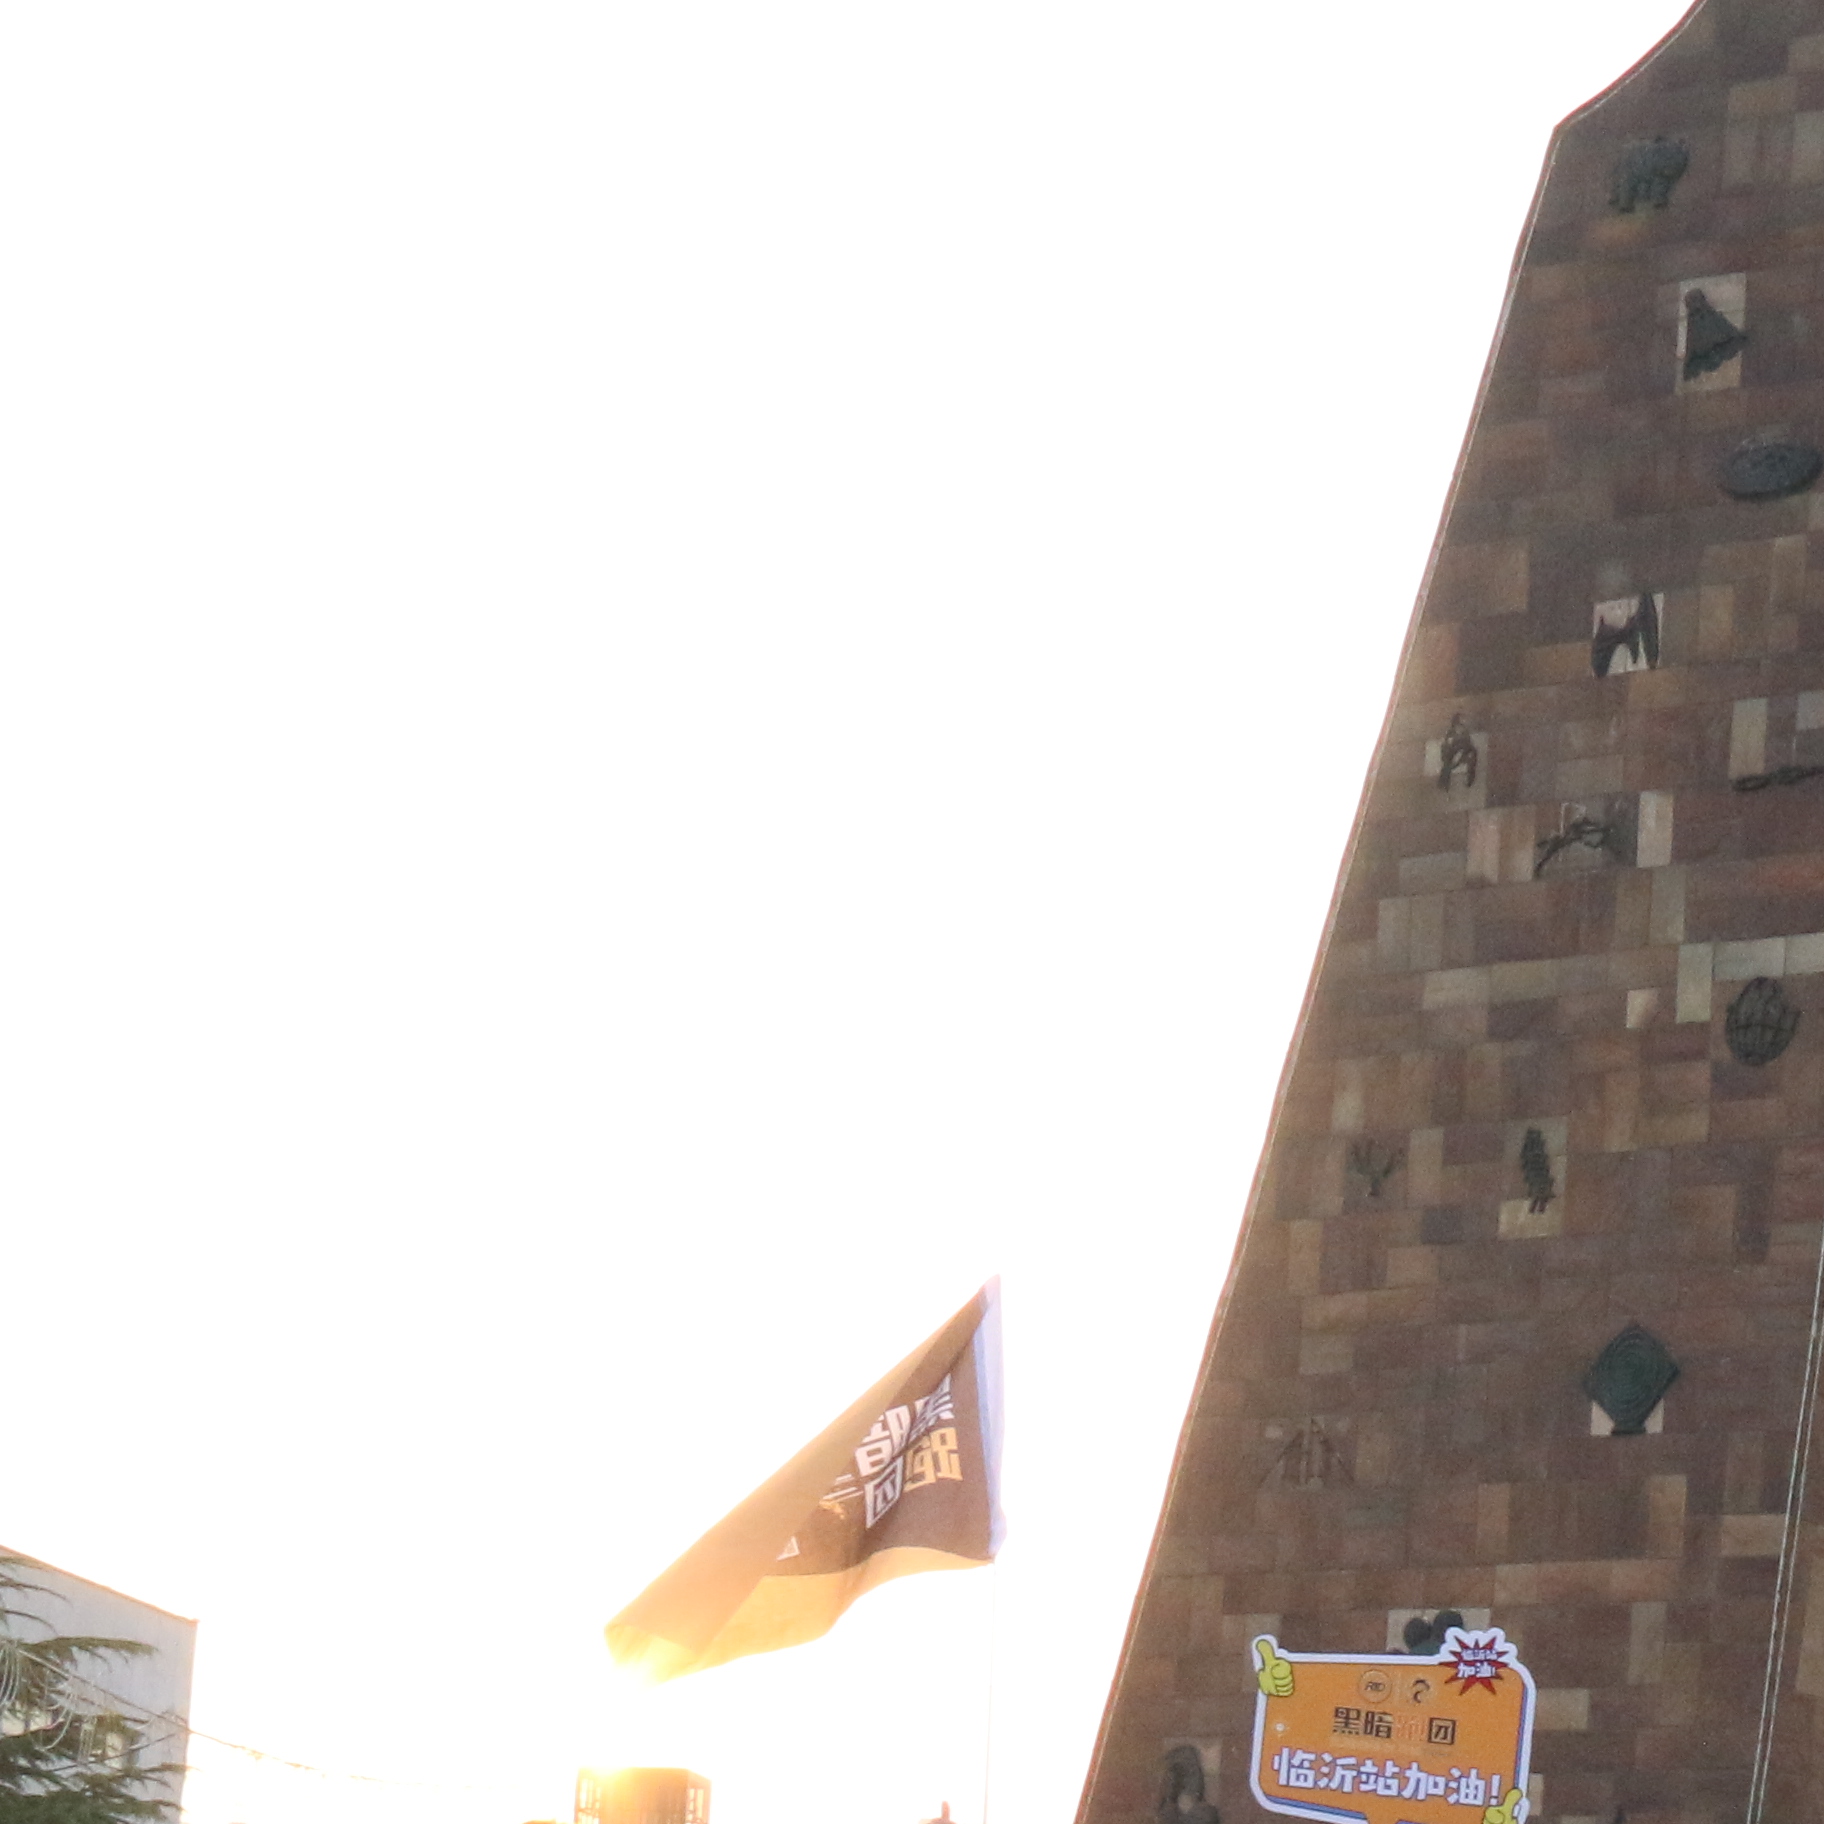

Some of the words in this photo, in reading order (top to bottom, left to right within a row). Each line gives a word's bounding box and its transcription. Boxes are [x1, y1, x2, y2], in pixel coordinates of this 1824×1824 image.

[1273, 1746, 1502, 1806] 临沂站加油!
